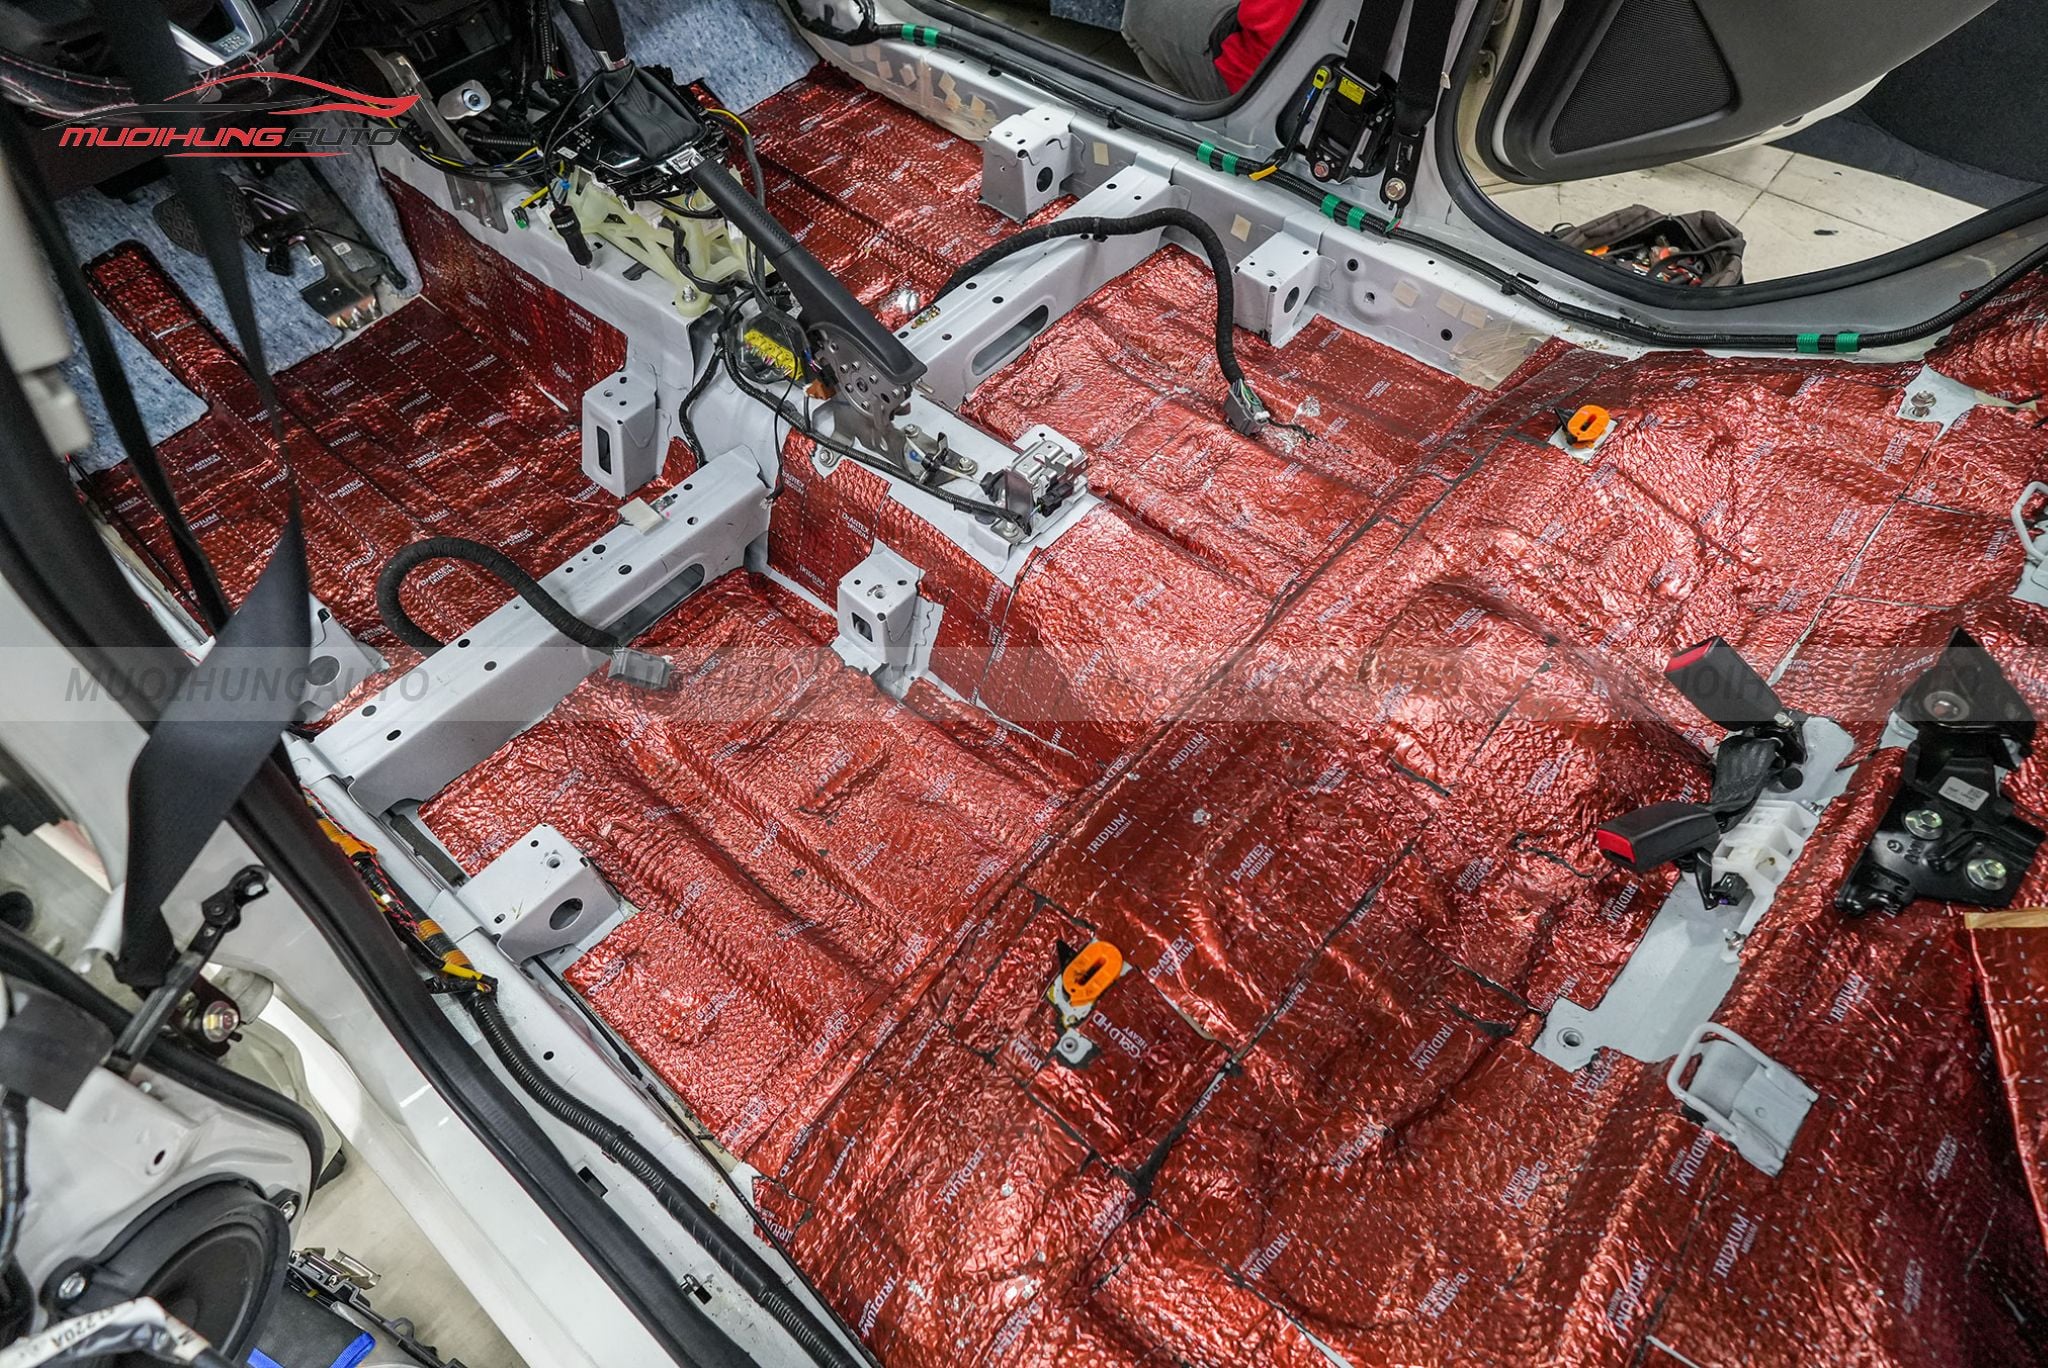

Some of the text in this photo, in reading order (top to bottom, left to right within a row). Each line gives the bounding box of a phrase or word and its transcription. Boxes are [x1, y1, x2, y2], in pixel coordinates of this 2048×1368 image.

[1104, 753, 1129, 778] GOLD
[1167, 731, 1206, 771] IRIDIUM
[1085, 812, 1127, 855] IRIDIUM
[964, 859, 1000, 895] GOLD HD
[1244, 847, 1274, 879] IRIDIUM
[1605, 881, 1638, 924] IRIDIUM
[891, 933, 928, 977] GOLD HD
[1163, 941, 1196, 977] IRIDIUM
[825, 1013, 850, 1040] GOLD
[1090, 1009, 1141, 1059] GOLD HD
[1121, 1025, 1147, 1049] HEAVY
[1413, 1022, 1454, 1070] IRIDIUM
[942, 1149, 985, 1204] IRIDIUM
[1246, 1231, 1290, 1281] IRIDIUM
[1714, 1213, 1750, 1278] IRIDIUM
[858, 1274, 897, 1336] IRIDIUM
[1614, 1259, 1648, 1330] IRIDIUM
